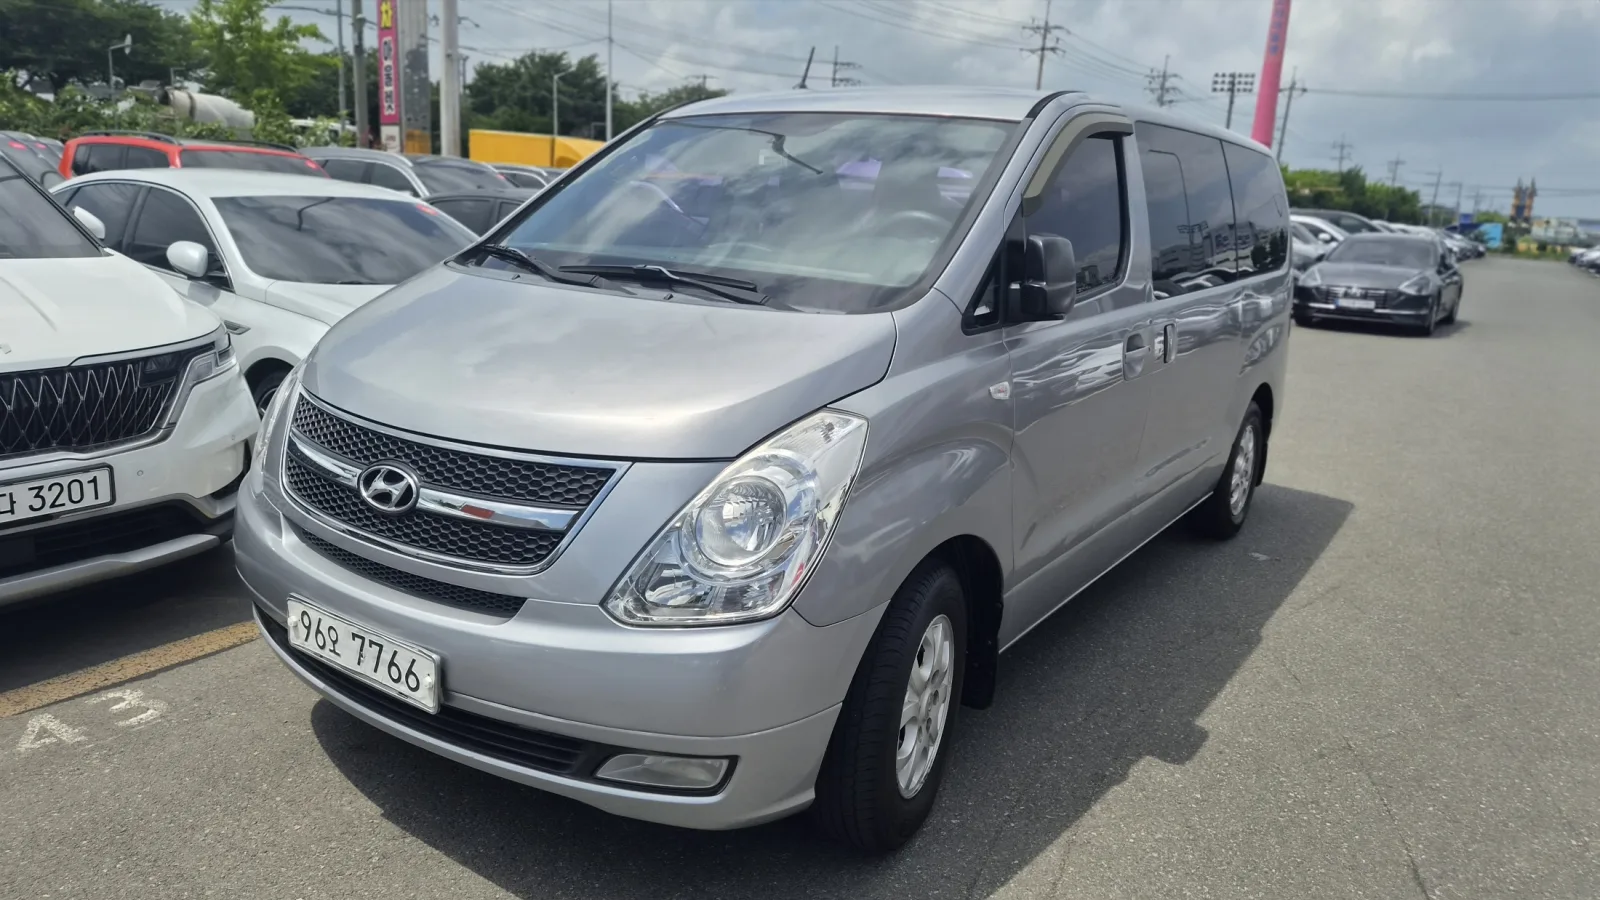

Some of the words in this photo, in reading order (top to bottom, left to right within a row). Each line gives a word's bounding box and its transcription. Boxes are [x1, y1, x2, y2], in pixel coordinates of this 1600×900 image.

[28, 475, 99, 512] 3201
[300, 610, 341, 657] 96오
[351, 632, 420, 693] 7766
